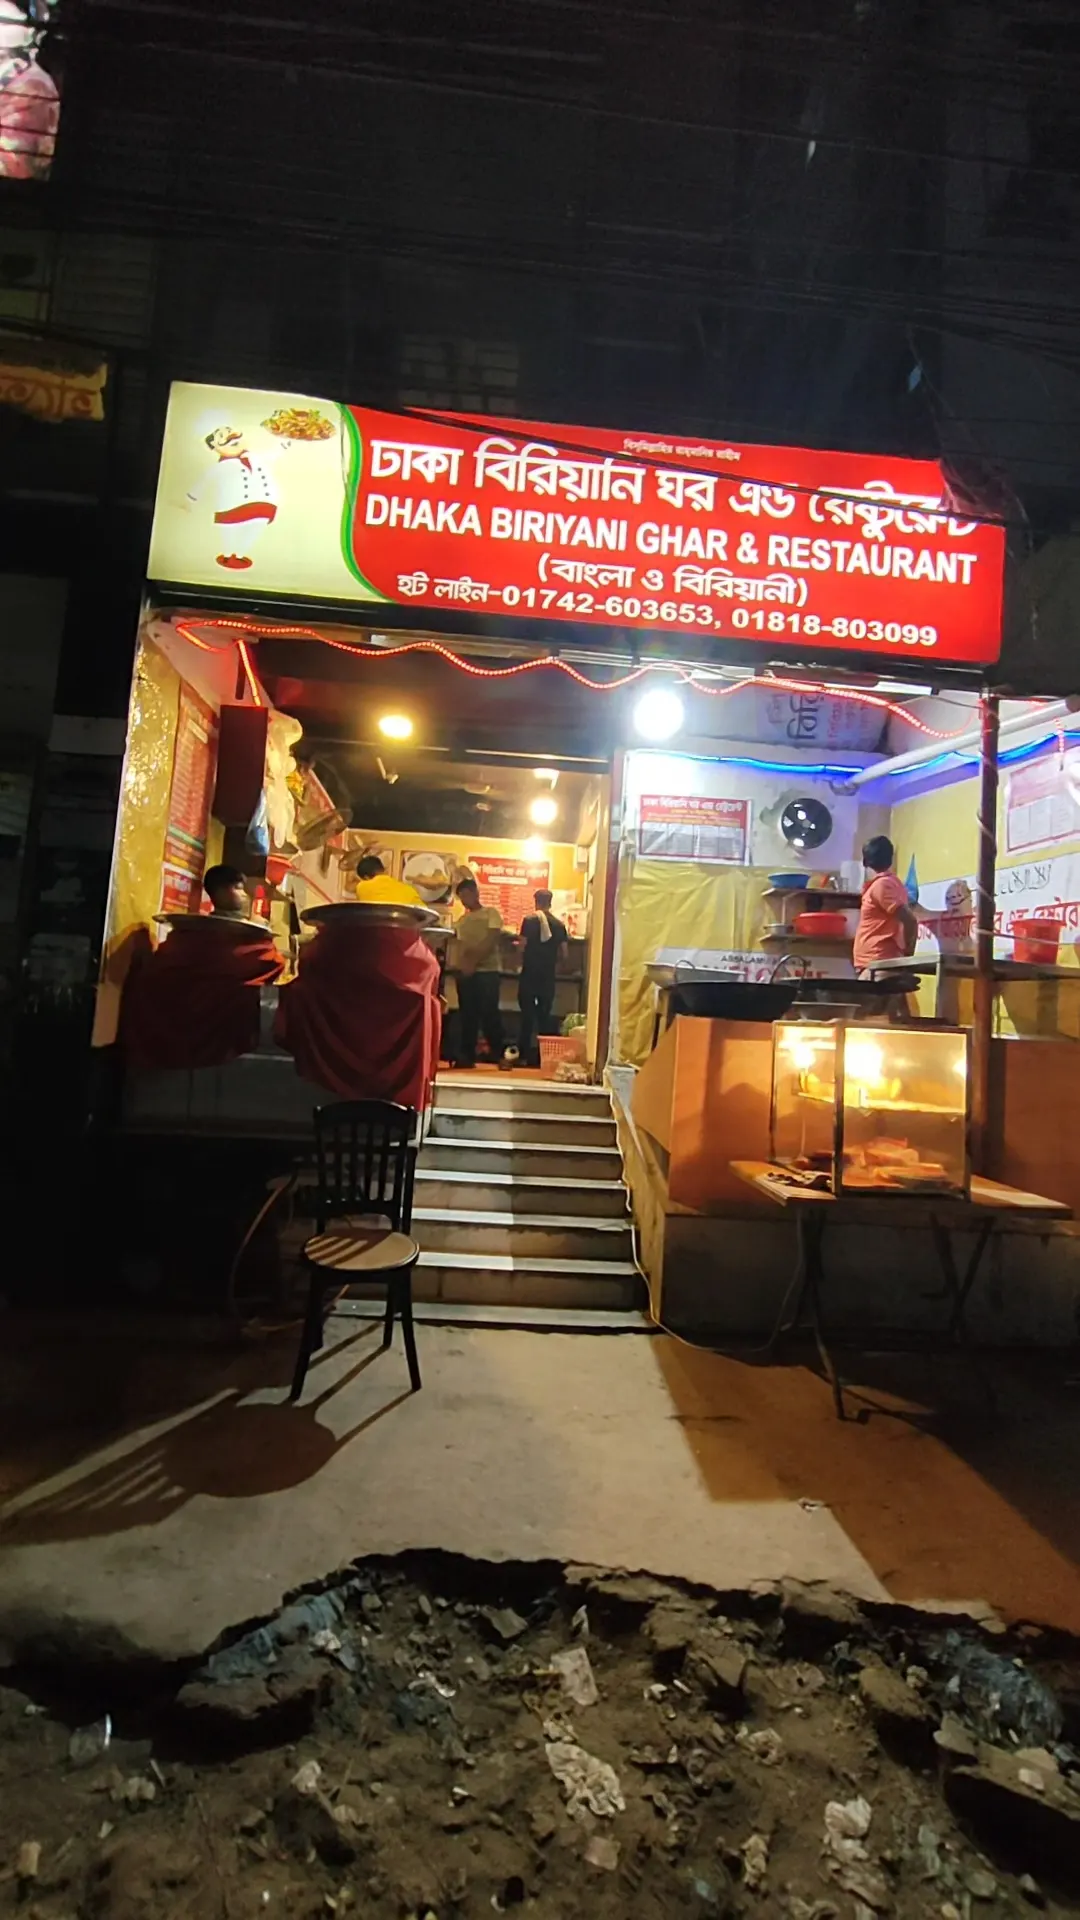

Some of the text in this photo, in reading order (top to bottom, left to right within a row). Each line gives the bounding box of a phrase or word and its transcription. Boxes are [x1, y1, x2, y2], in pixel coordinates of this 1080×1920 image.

[370, 439, 465, 486] ঢাকা
[472, 437, 647, 505] বিরিয়ানি
[655, 469, 719, 512] ঘর
[365, 493, 978, 585] DHAKA BIRIYANI GHAR & RESTAURANT
[397, 571, 430, 597] হট
[731, 607, 938, 647] 01818-803099
[537, 552, 809, 608] (বাংলা ও বিরিয়ানী)
